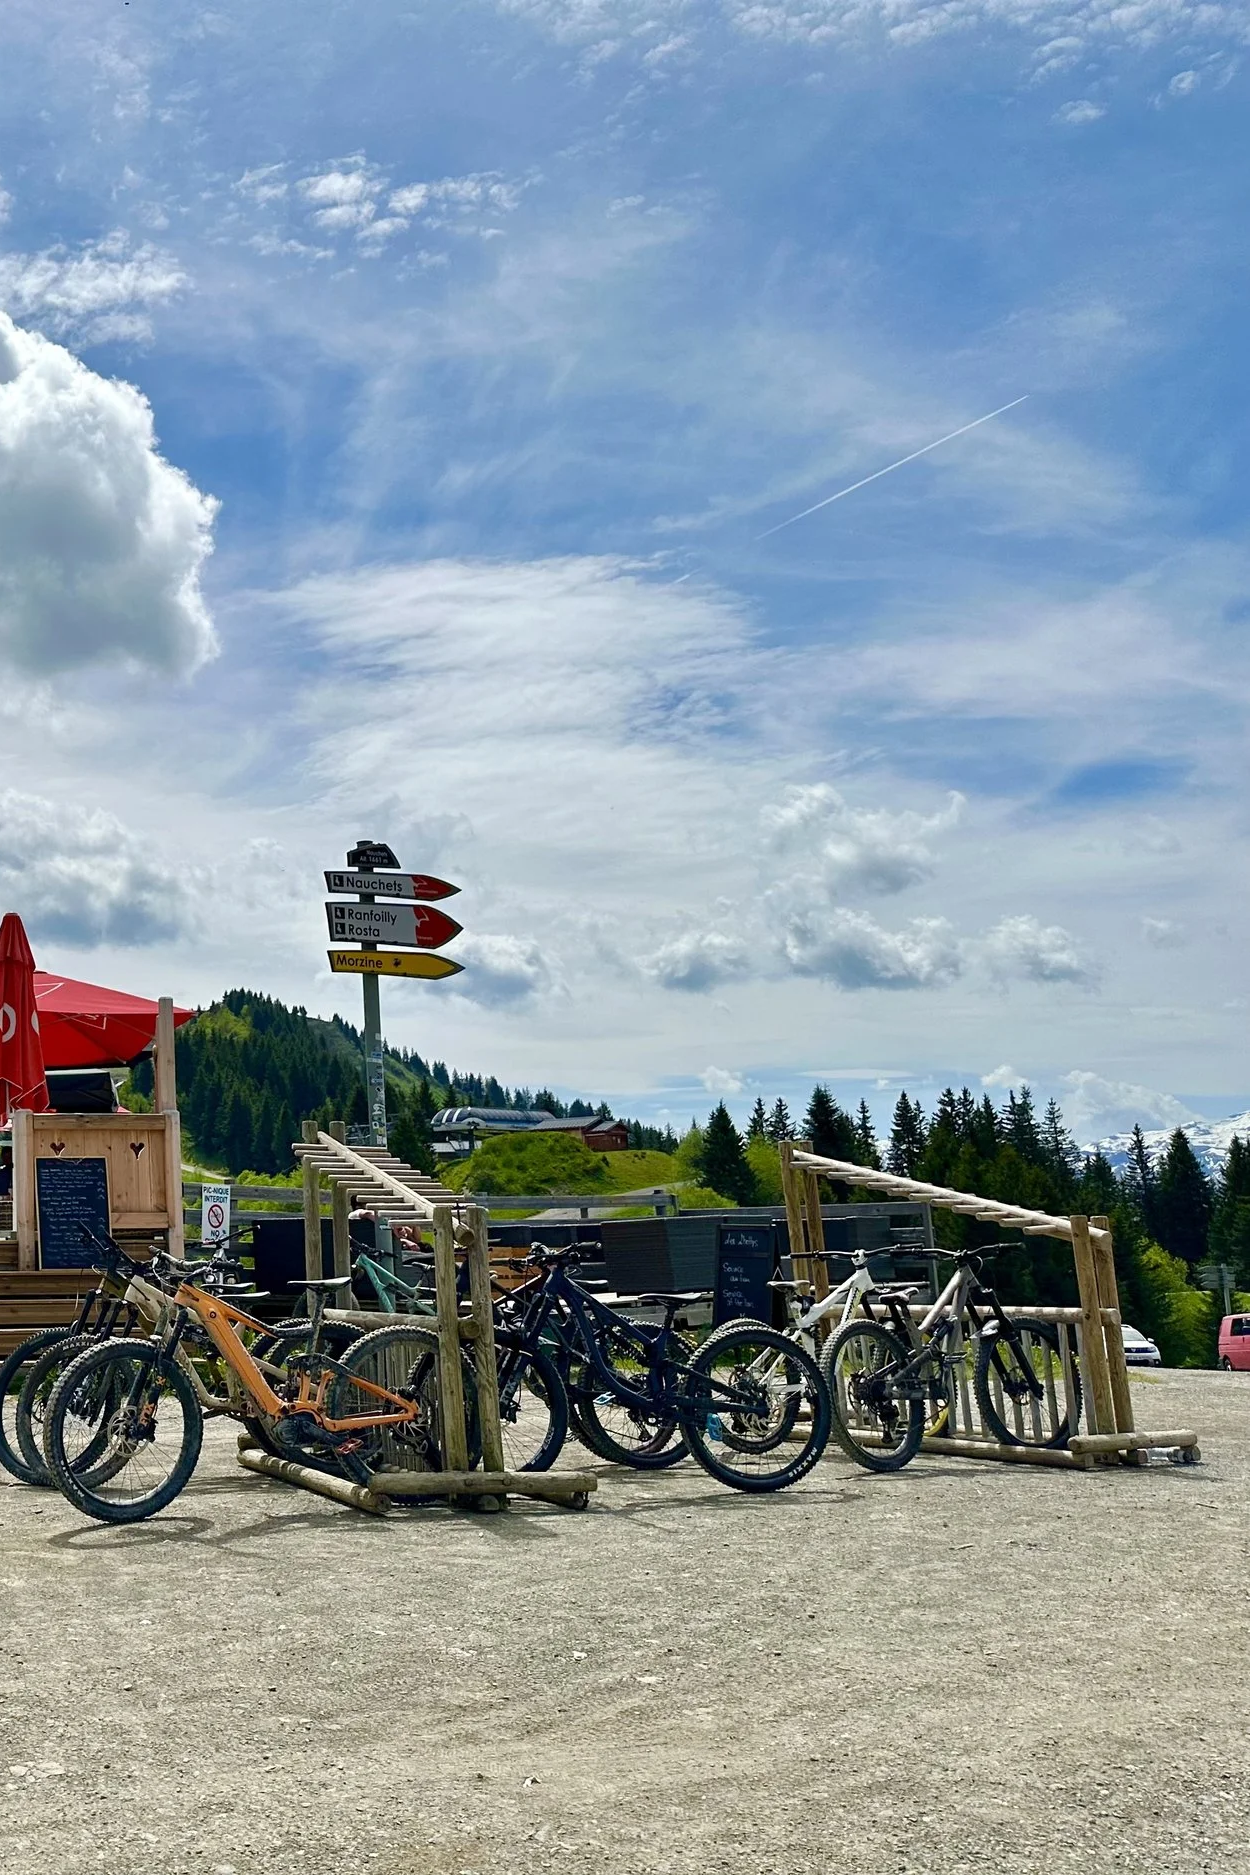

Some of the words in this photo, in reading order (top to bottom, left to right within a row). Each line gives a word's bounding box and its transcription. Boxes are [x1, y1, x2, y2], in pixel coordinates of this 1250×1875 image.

[346, 876, 403, 892] Nauchets
[348, 908, 397, 926] Ranfoilly
[348, 923, 380, 937] Rosta
[336, 954, 383, 968] Morzine
[203, 1187, 229, 1195] PIC-NIQUE
[788, 1446, 818, 1478] MAXXIS
